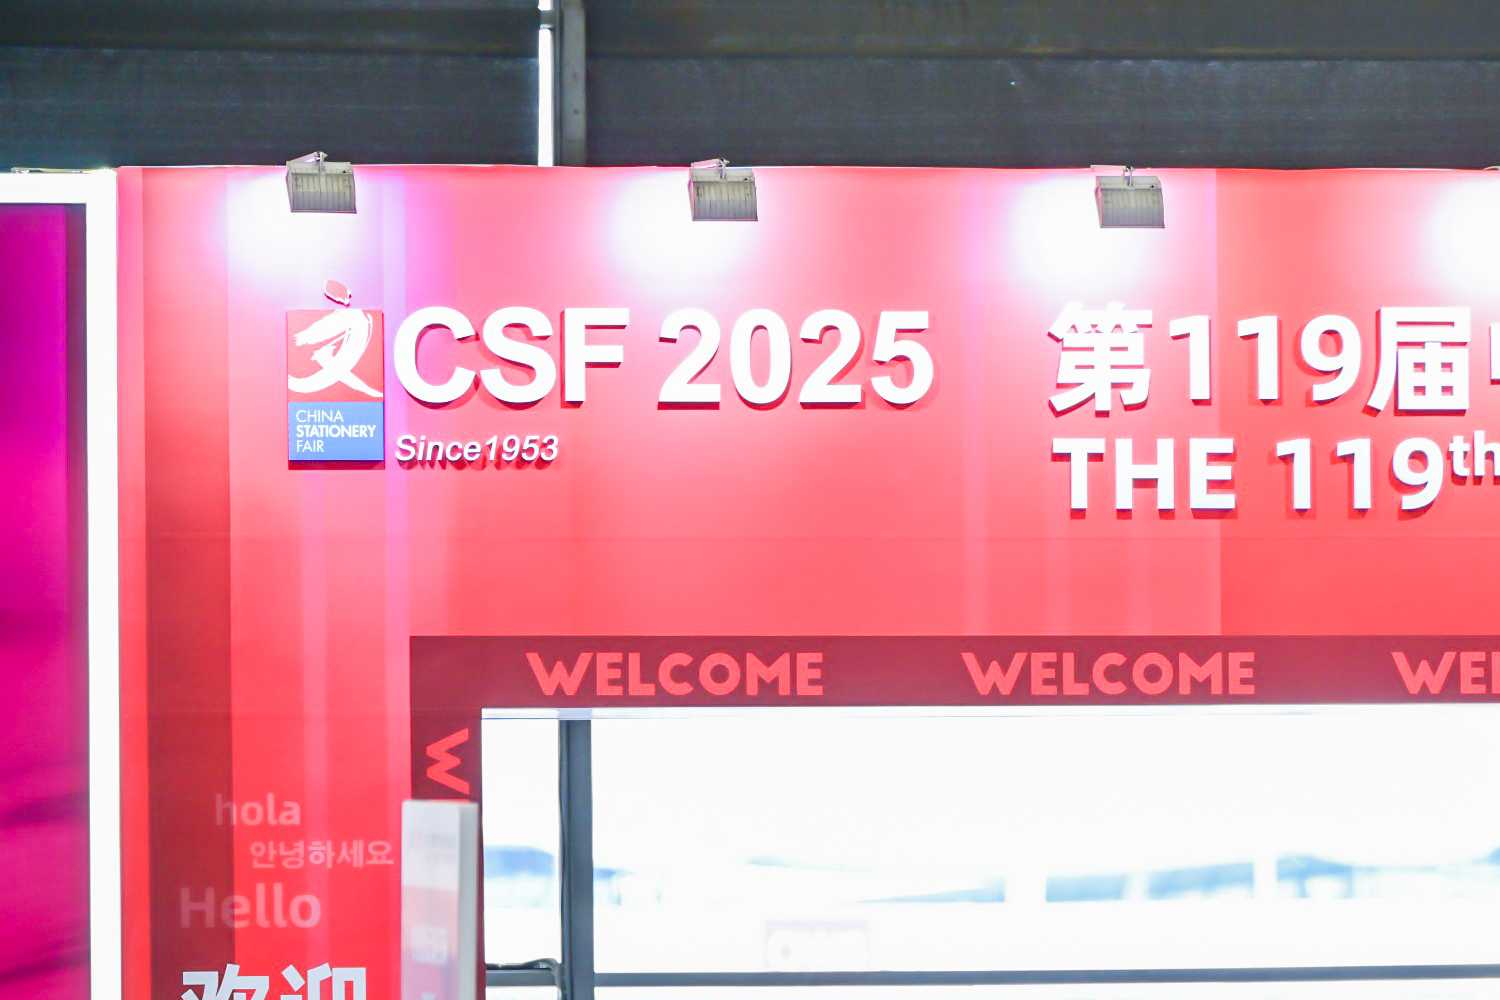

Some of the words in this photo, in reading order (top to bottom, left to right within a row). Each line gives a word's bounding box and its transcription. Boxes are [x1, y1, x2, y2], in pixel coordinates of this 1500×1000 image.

[393, 306, 631, 404] CSF
[658, 308, 934, 404] 2025
[295, 409, 344, 423] CHINA
[295, 424, 377, 438] STATIONERY
[295, 439, 325, 453] FAIR
[395, 434, 559, 462] Since1953
[1052, 437, 1235, 510] THE
[526, 652, 824, 696] WELCOME
[962, 651, 1256, 696] WELCOME
[215, 793, 301, 826] hola
[250, 840, 394, 870] 안녕하세요
[179, 882, 322, 929] Hello
